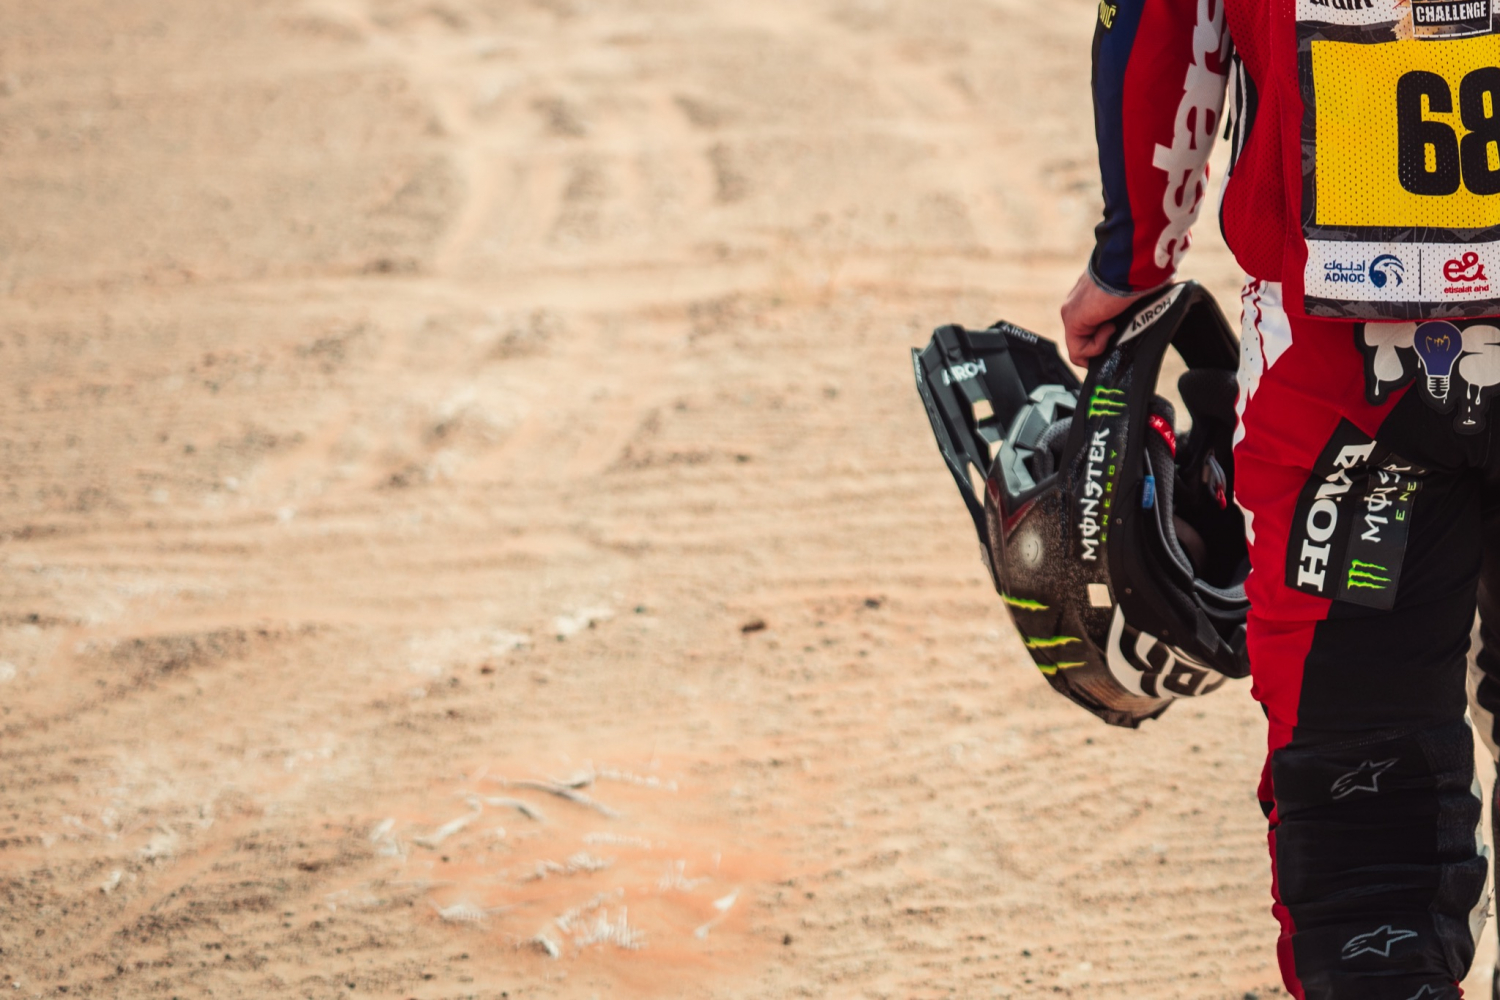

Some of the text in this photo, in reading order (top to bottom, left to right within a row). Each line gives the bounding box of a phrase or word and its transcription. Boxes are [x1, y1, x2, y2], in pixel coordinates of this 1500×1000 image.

[1415, 1, 1487, 23] CHALLENGE
[1324, 272, 1365, 283] ADNOC
[1131, 297, 1172, 332] AIROH
[1001, 323, 1039, 344] AIROH
[1078, 427, 1110, 561] MONSTER
[1101, 449, 1117, 542] ENERGY
